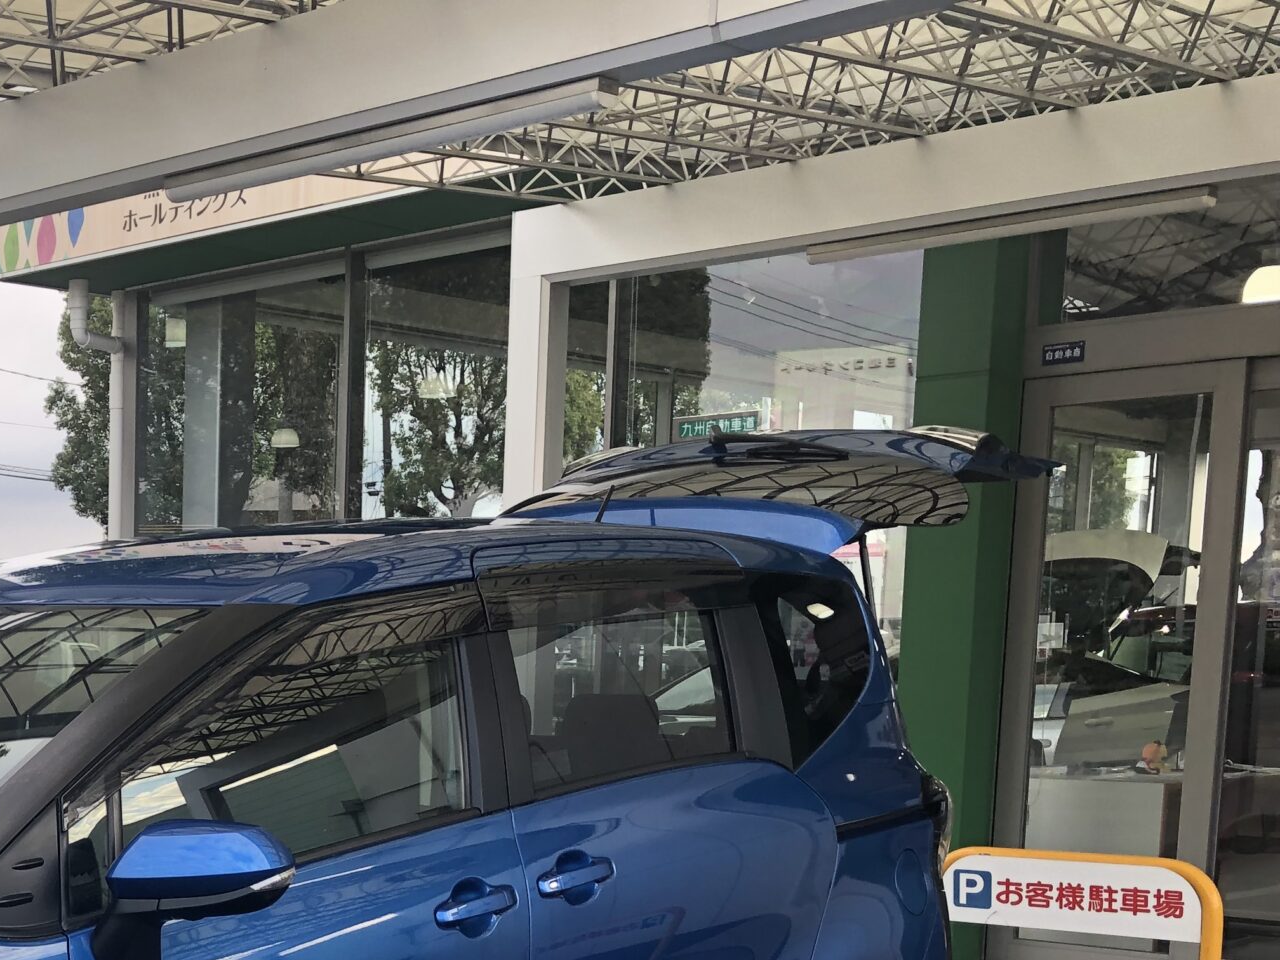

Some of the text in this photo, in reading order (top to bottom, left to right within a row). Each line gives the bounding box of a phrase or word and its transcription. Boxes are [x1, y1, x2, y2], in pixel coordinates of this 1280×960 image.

[680, 416, 756, 437] 九州自動車道
[959, 872, 1185, 919] P お客様駐車場
